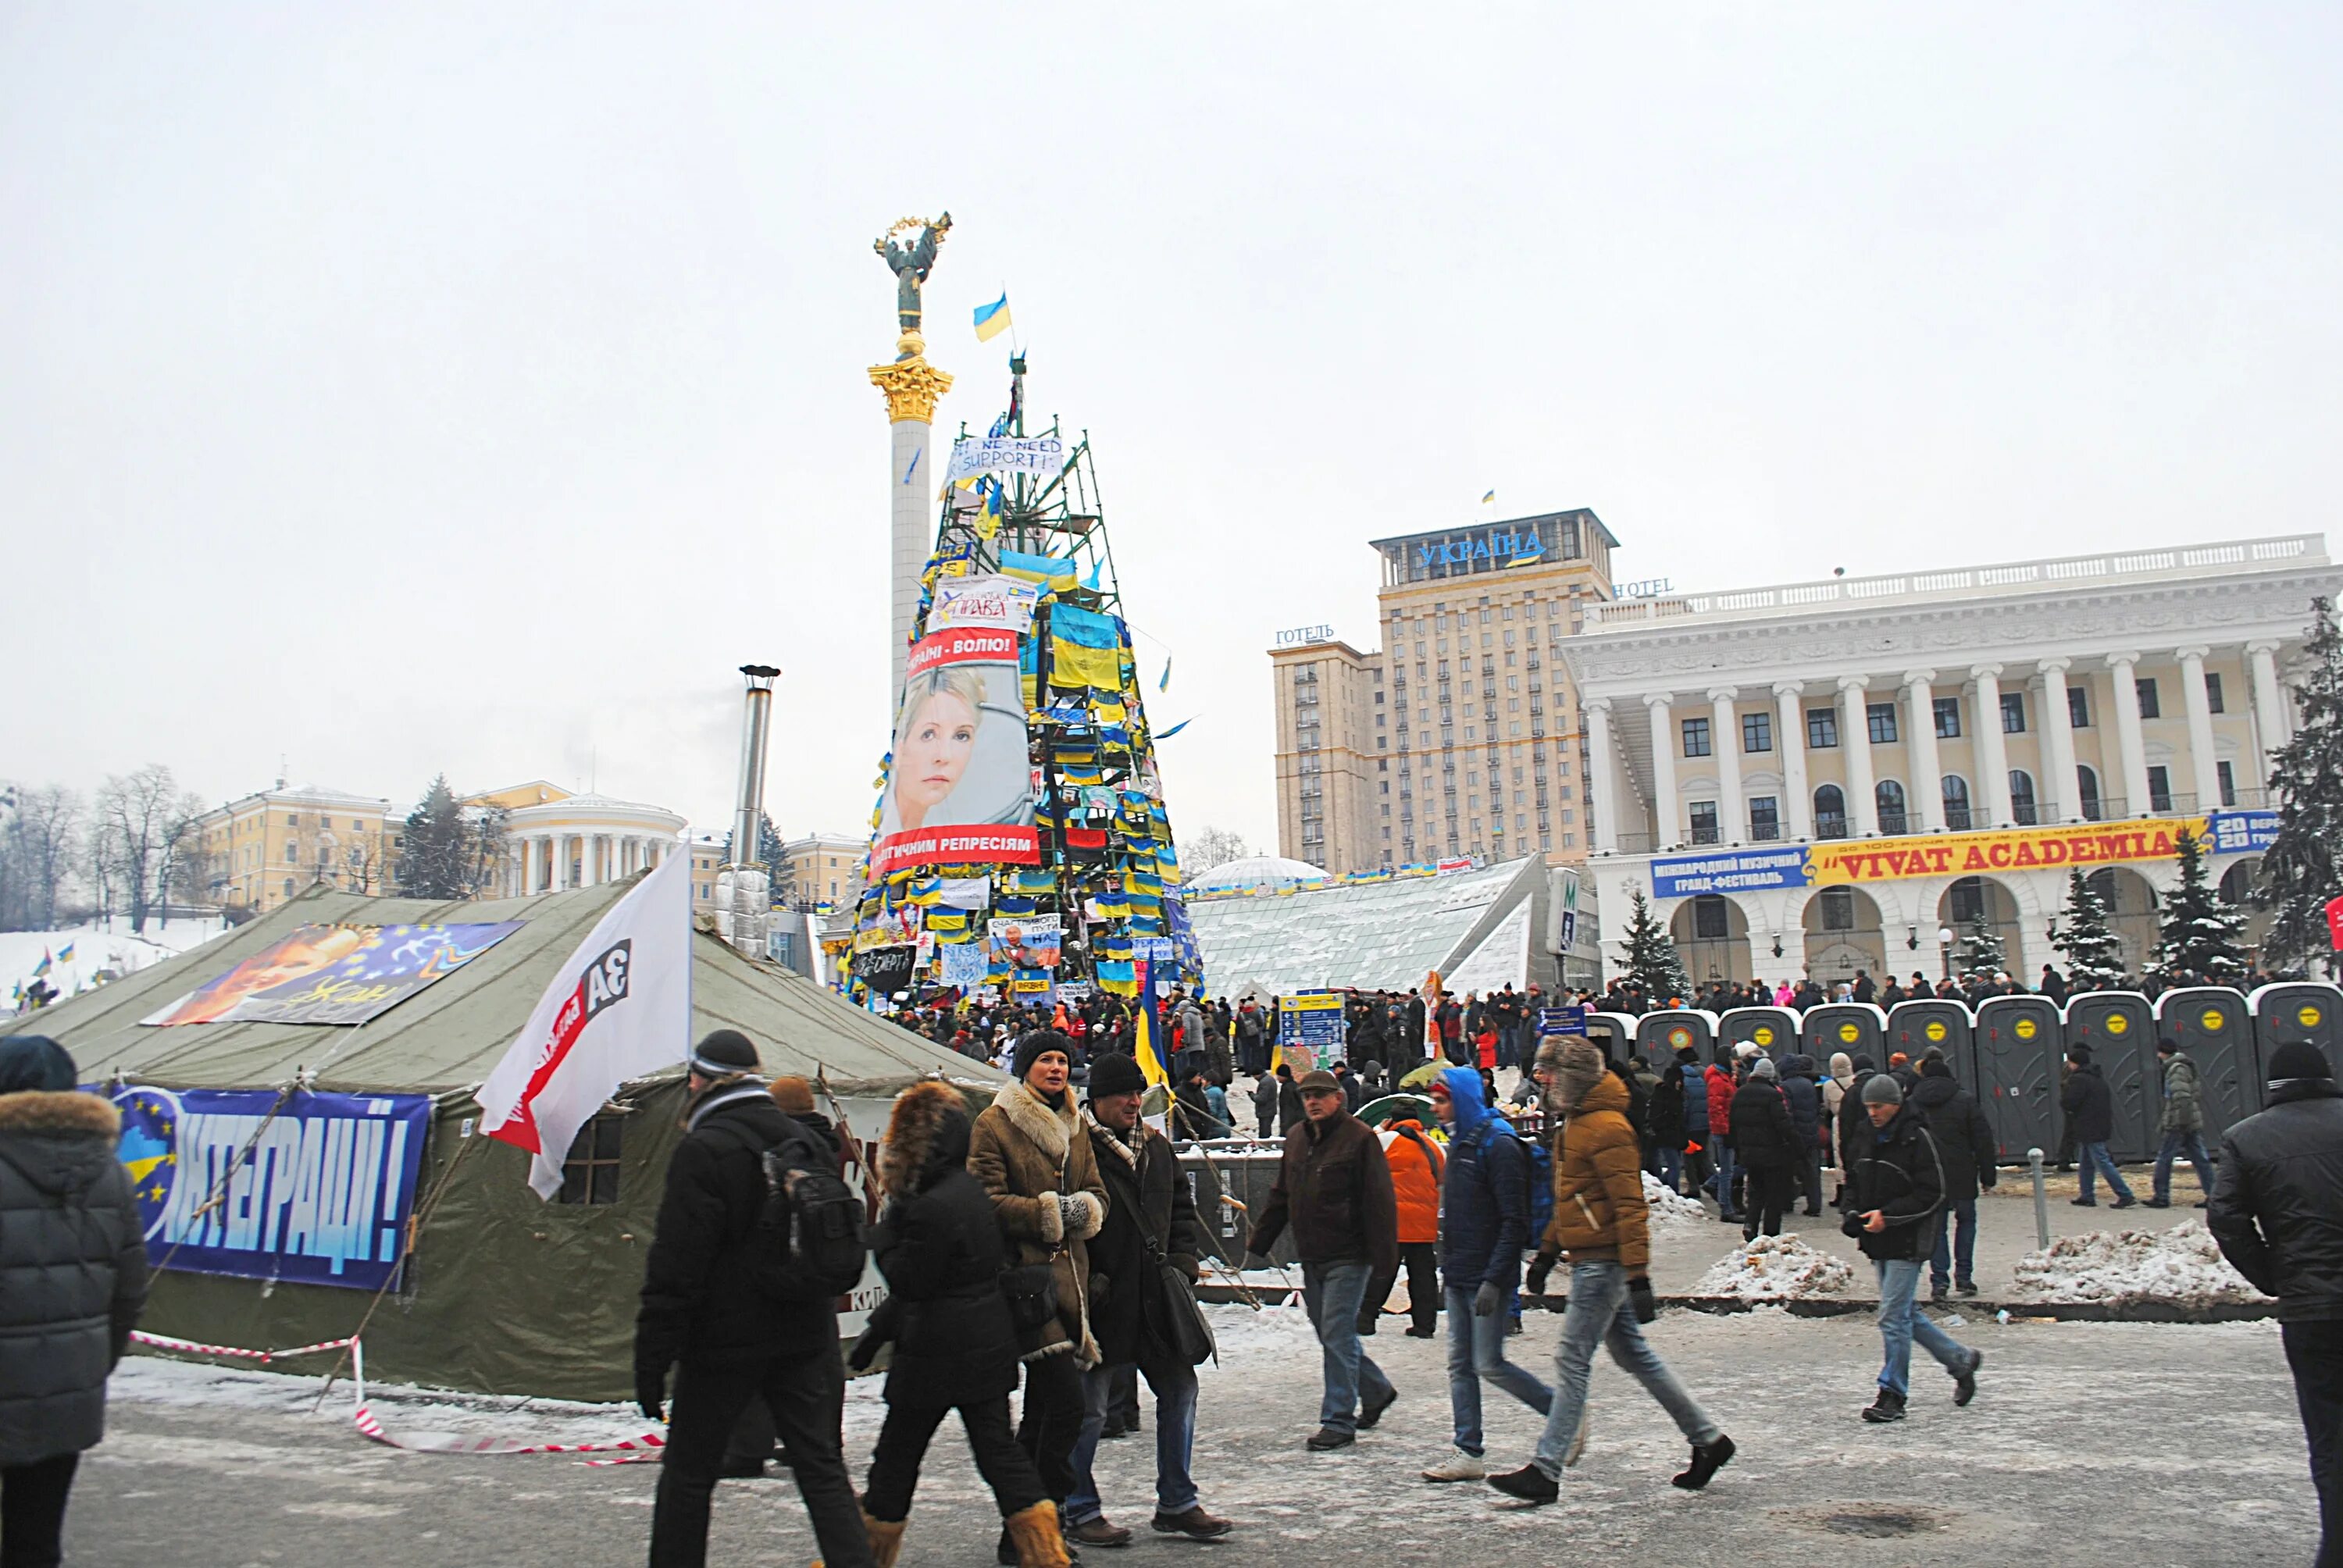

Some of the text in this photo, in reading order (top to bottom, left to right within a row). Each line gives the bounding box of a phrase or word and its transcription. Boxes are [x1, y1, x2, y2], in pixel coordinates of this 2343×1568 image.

[1017, 439, 1061, 454] NEED
[1419, 531, 1545, 568] УКРАЇНА
[1612, 578, 1674, 599] HOTEL
[1276, 624, 1334, 644] ГОТЕЛЬ
[953, 638, 1011, 654] ВОЛЮ!
[2216, 818, 2247, 834] 20
[940, 836, 1031, 852] РЕПРЕСІЯМ
[2219, 832, 2249, 849] 20
[1654, 852, 1801, 878] МІЖНАРОДНИЙ МУЗИЧНИЙ
[1675, 871, 1784, 892] ГРАНД-ФЕСТИВАЛЬ
[992, 914, 1058, 928] СЧАСТЛИВОГО
[1032, 923, 1058, 933] ПУТИ
